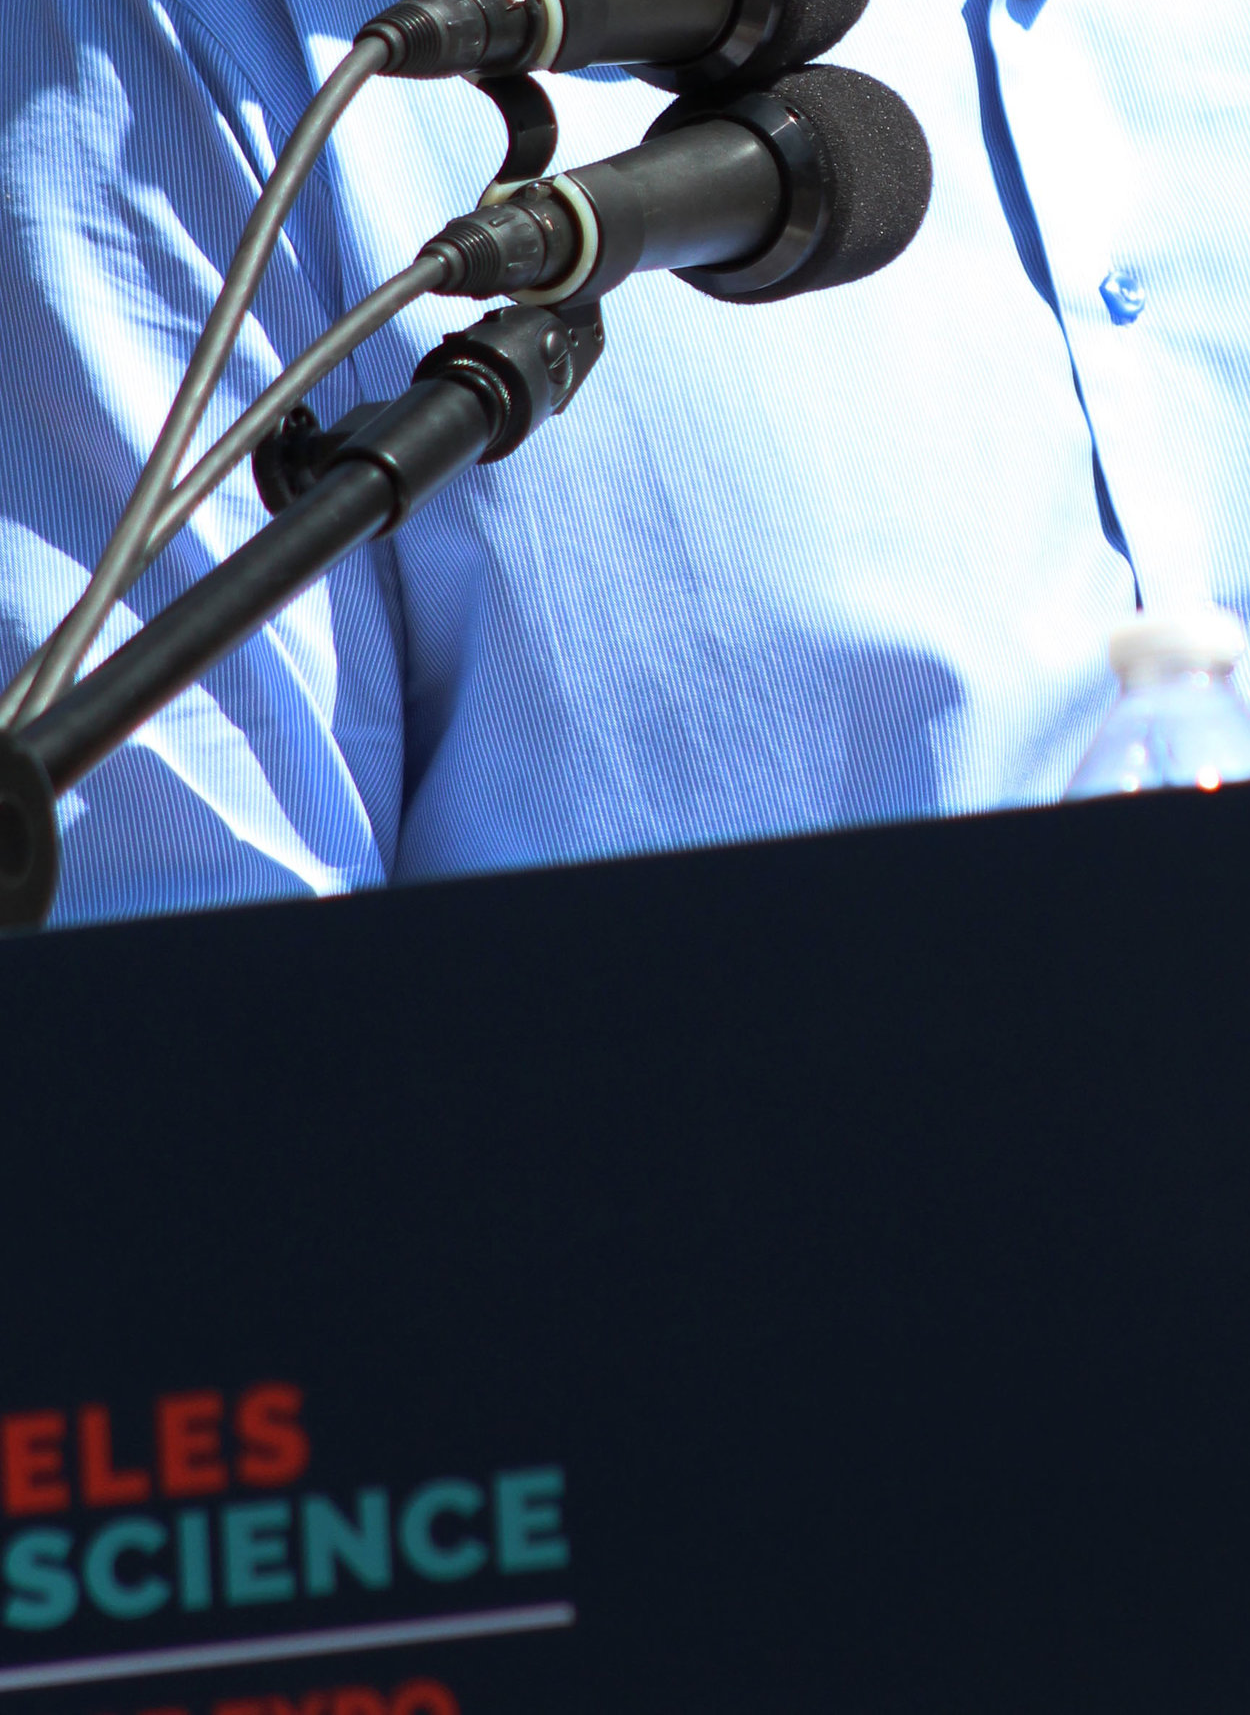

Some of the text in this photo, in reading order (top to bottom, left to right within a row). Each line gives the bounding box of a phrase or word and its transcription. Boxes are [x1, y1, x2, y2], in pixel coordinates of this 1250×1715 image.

[1, 1383, 309, 1516] ELES
[3, 1469, 568, 1629] SCIENCE
[213, 1679, 459, 1715] PO
